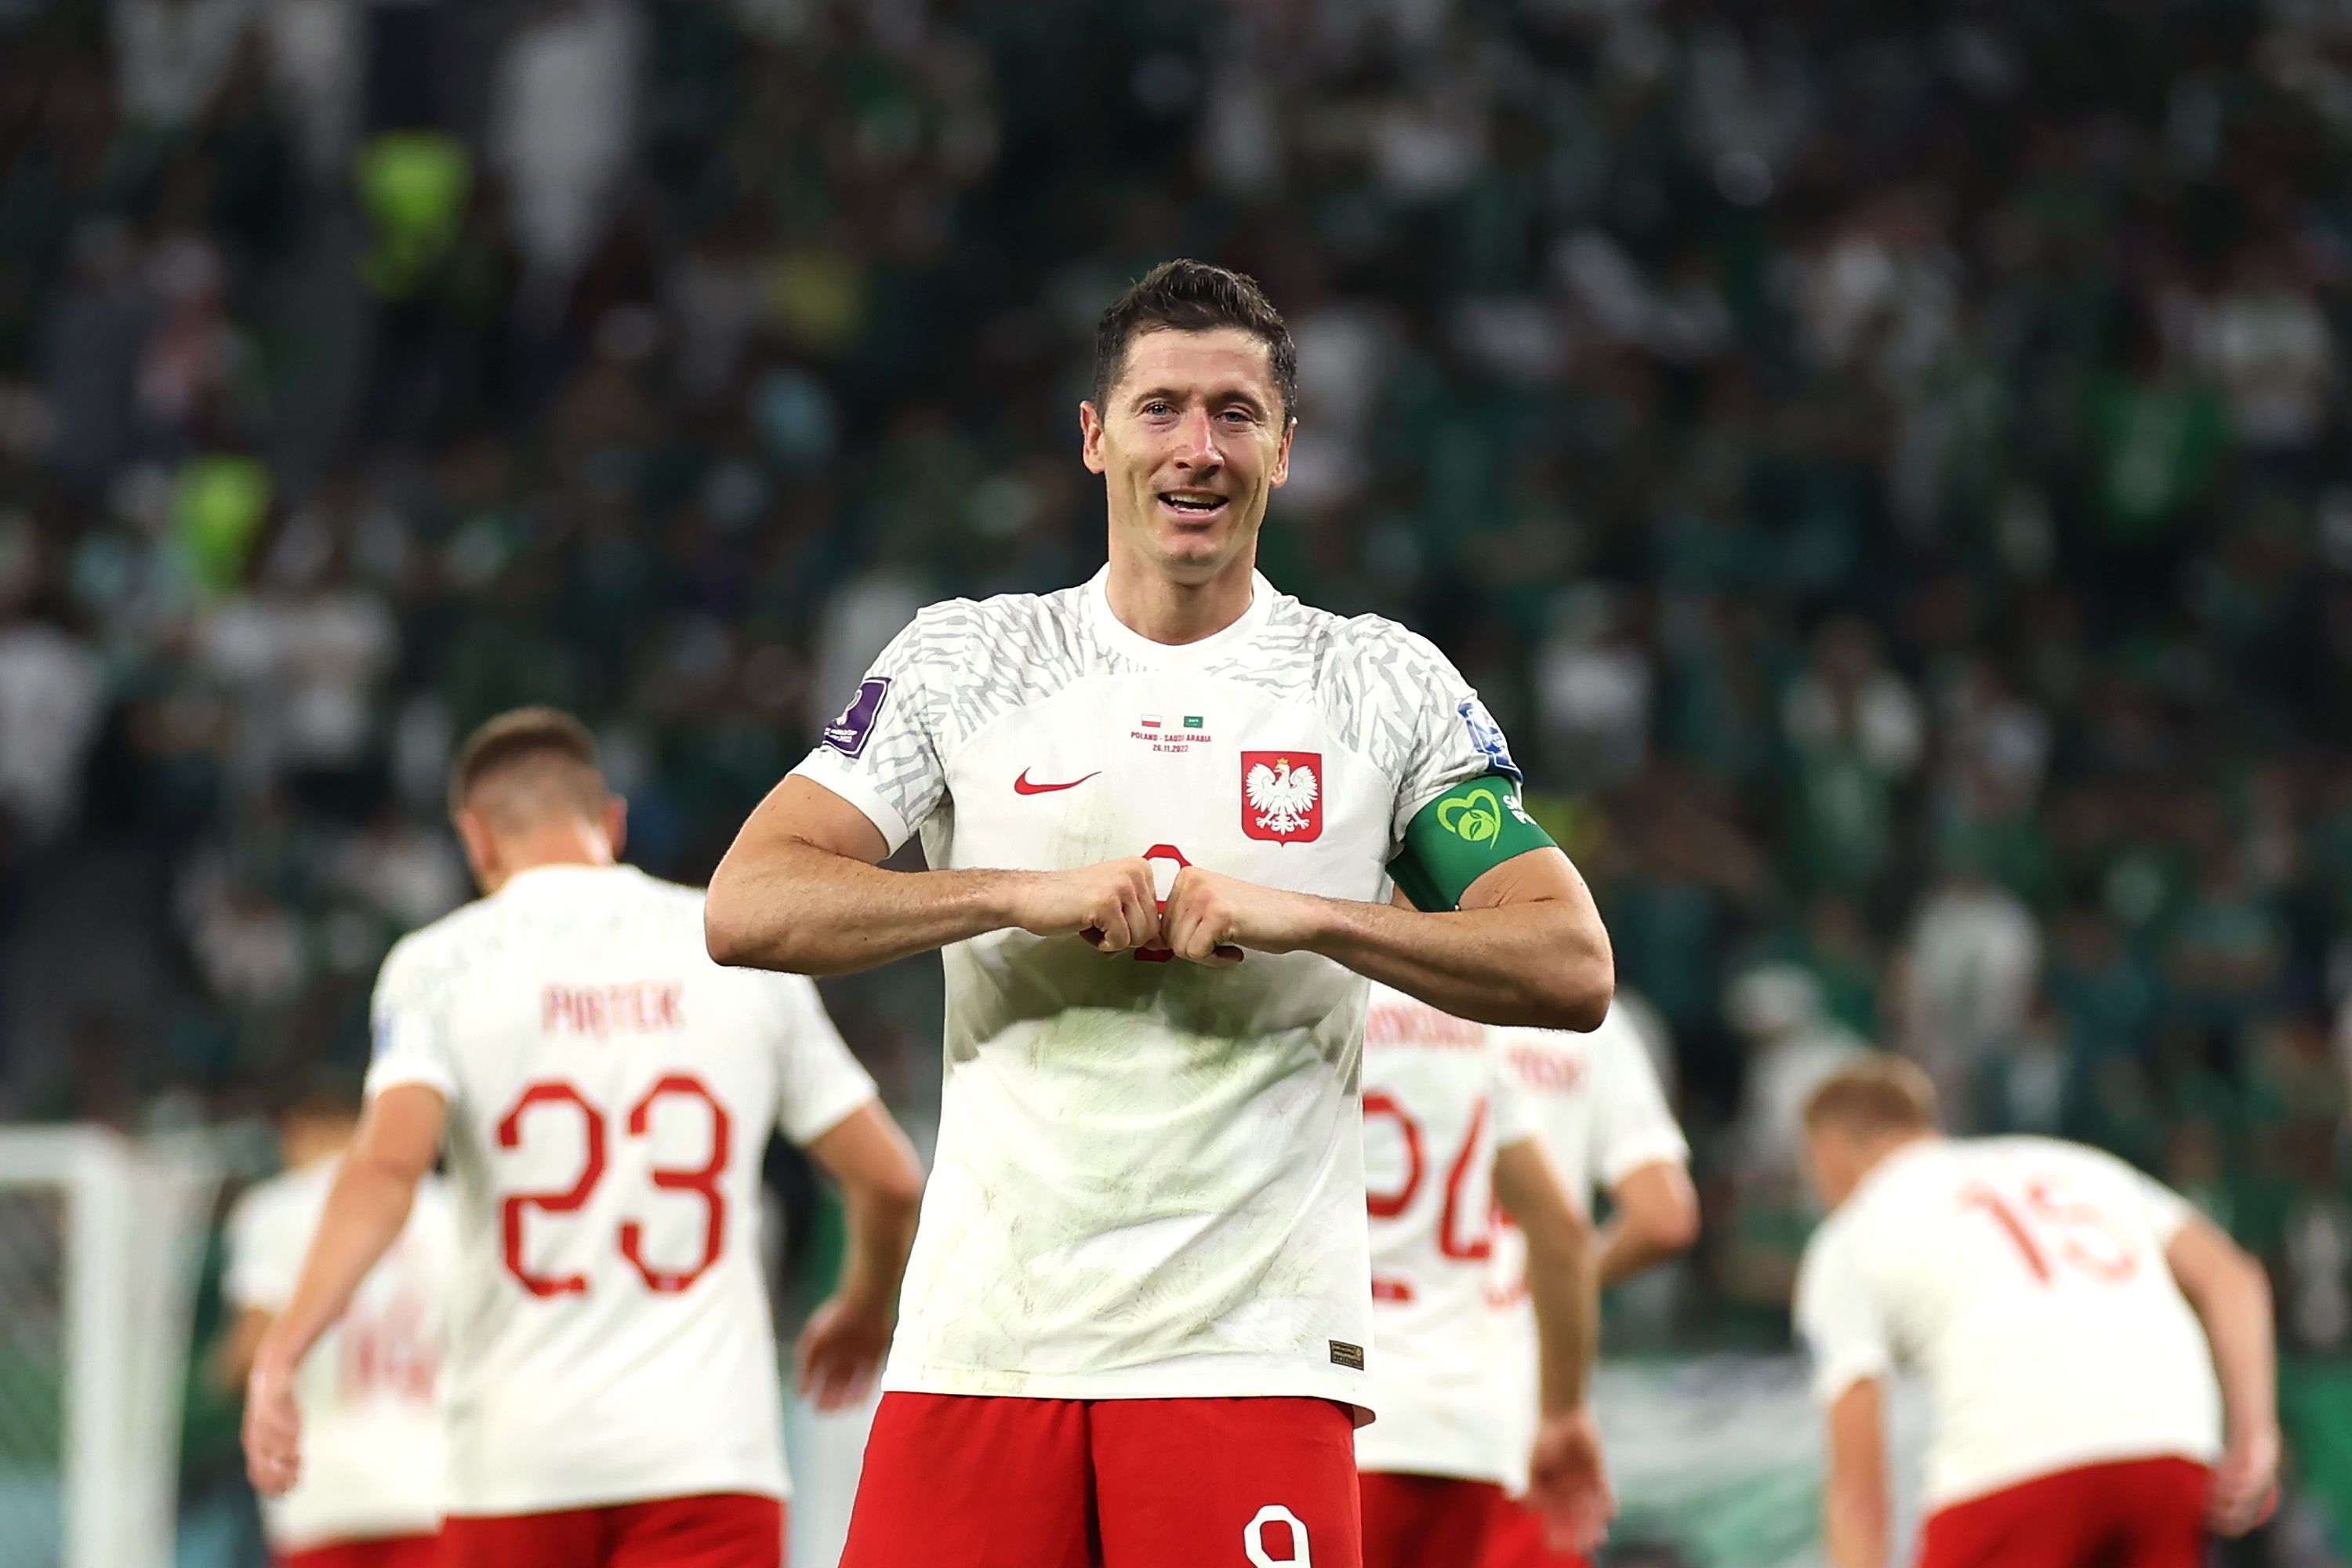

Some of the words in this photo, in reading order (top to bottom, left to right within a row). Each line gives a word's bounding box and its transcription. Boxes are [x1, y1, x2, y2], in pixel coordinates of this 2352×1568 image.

[1131, 731, 1158, 741] POLAND
[1186, 734, 1211, 742] ARABIA
[1152, 744, 1189, 753] 26.11.2022
[498, 1071, 732, 1298] 23
[1958, 1176, 2140, 1286] 15
